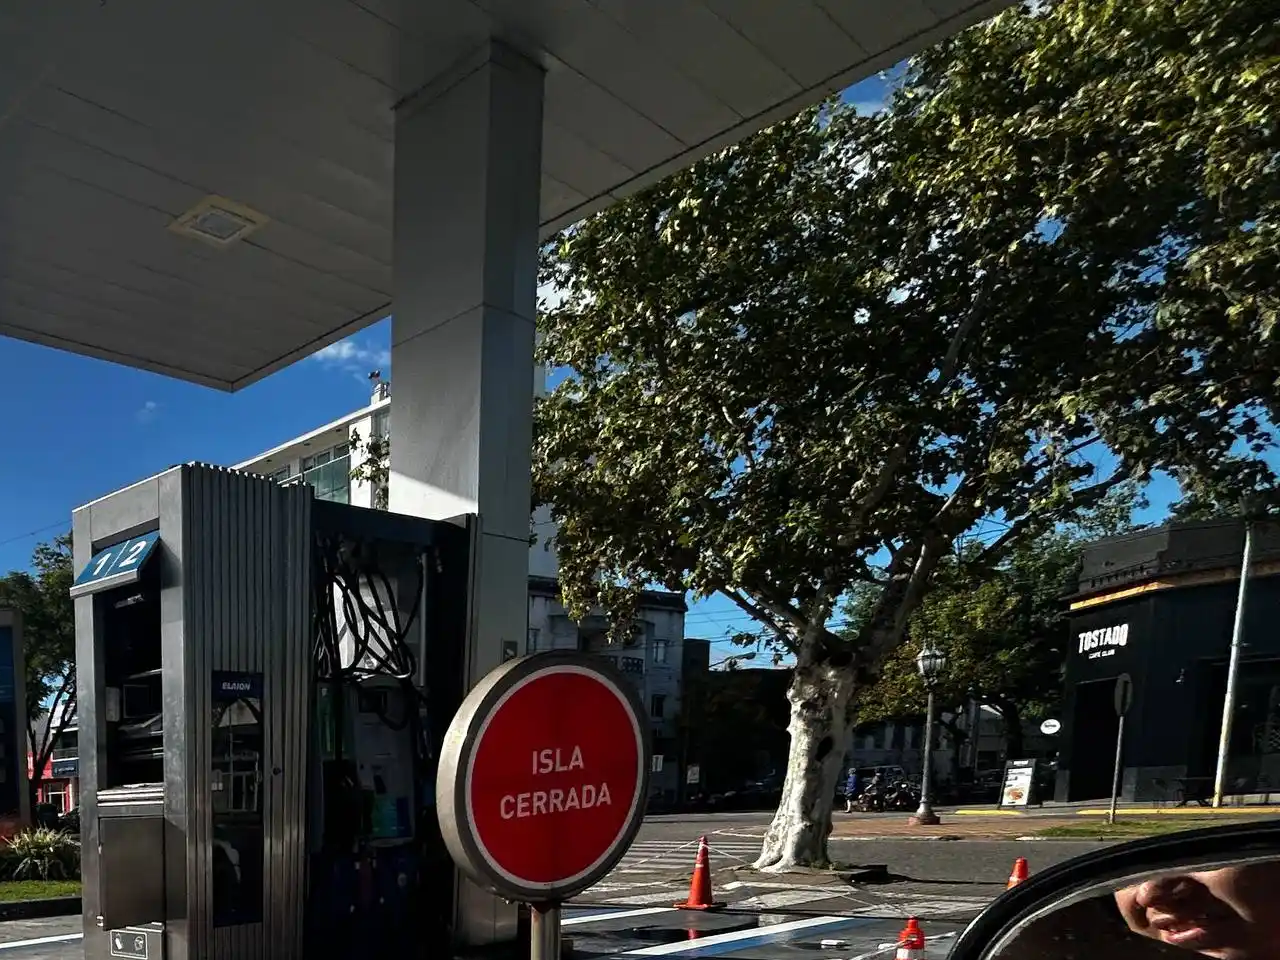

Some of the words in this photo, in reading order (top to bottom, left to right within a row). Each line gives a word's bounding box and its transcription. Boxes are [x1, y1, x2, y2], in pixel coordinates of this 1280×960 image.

[92, 552, 111, 576] 1
[118, 540, 147, 567] 2
[1078, 623, 1129, 654] TOSTADO
[532, 745, 585, 775] ISLA
[500, 782, 612, 820] CERRADA
